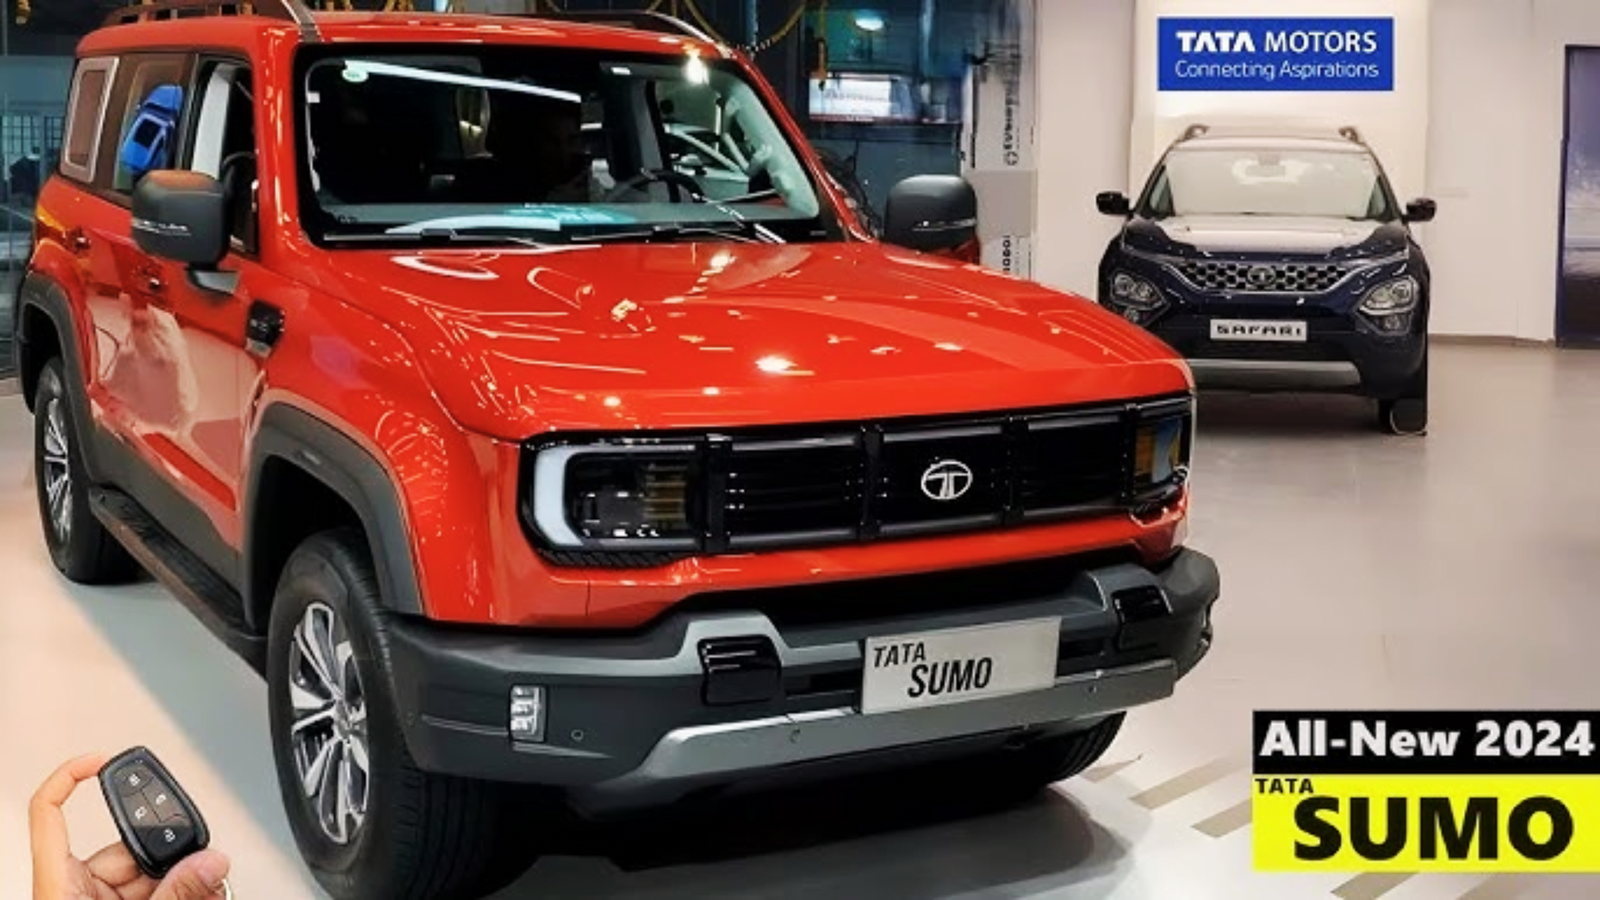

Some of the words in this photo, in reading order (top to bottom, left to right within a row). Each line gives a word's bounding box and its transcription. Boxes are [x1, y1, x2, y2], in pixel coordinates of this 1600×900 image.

[1176, 31, 1256, 52] TATA
[1265, 31, 1377, 53] MOTORS
[1175, 60, 1275, 81] Connecting
[1279, 60, 1379, 80] Aspirations
[1217, 325, 1301, 336] SAFARI
[874, 642, 926, 668] TATA
[907, 657, 993, 697] SUMO
